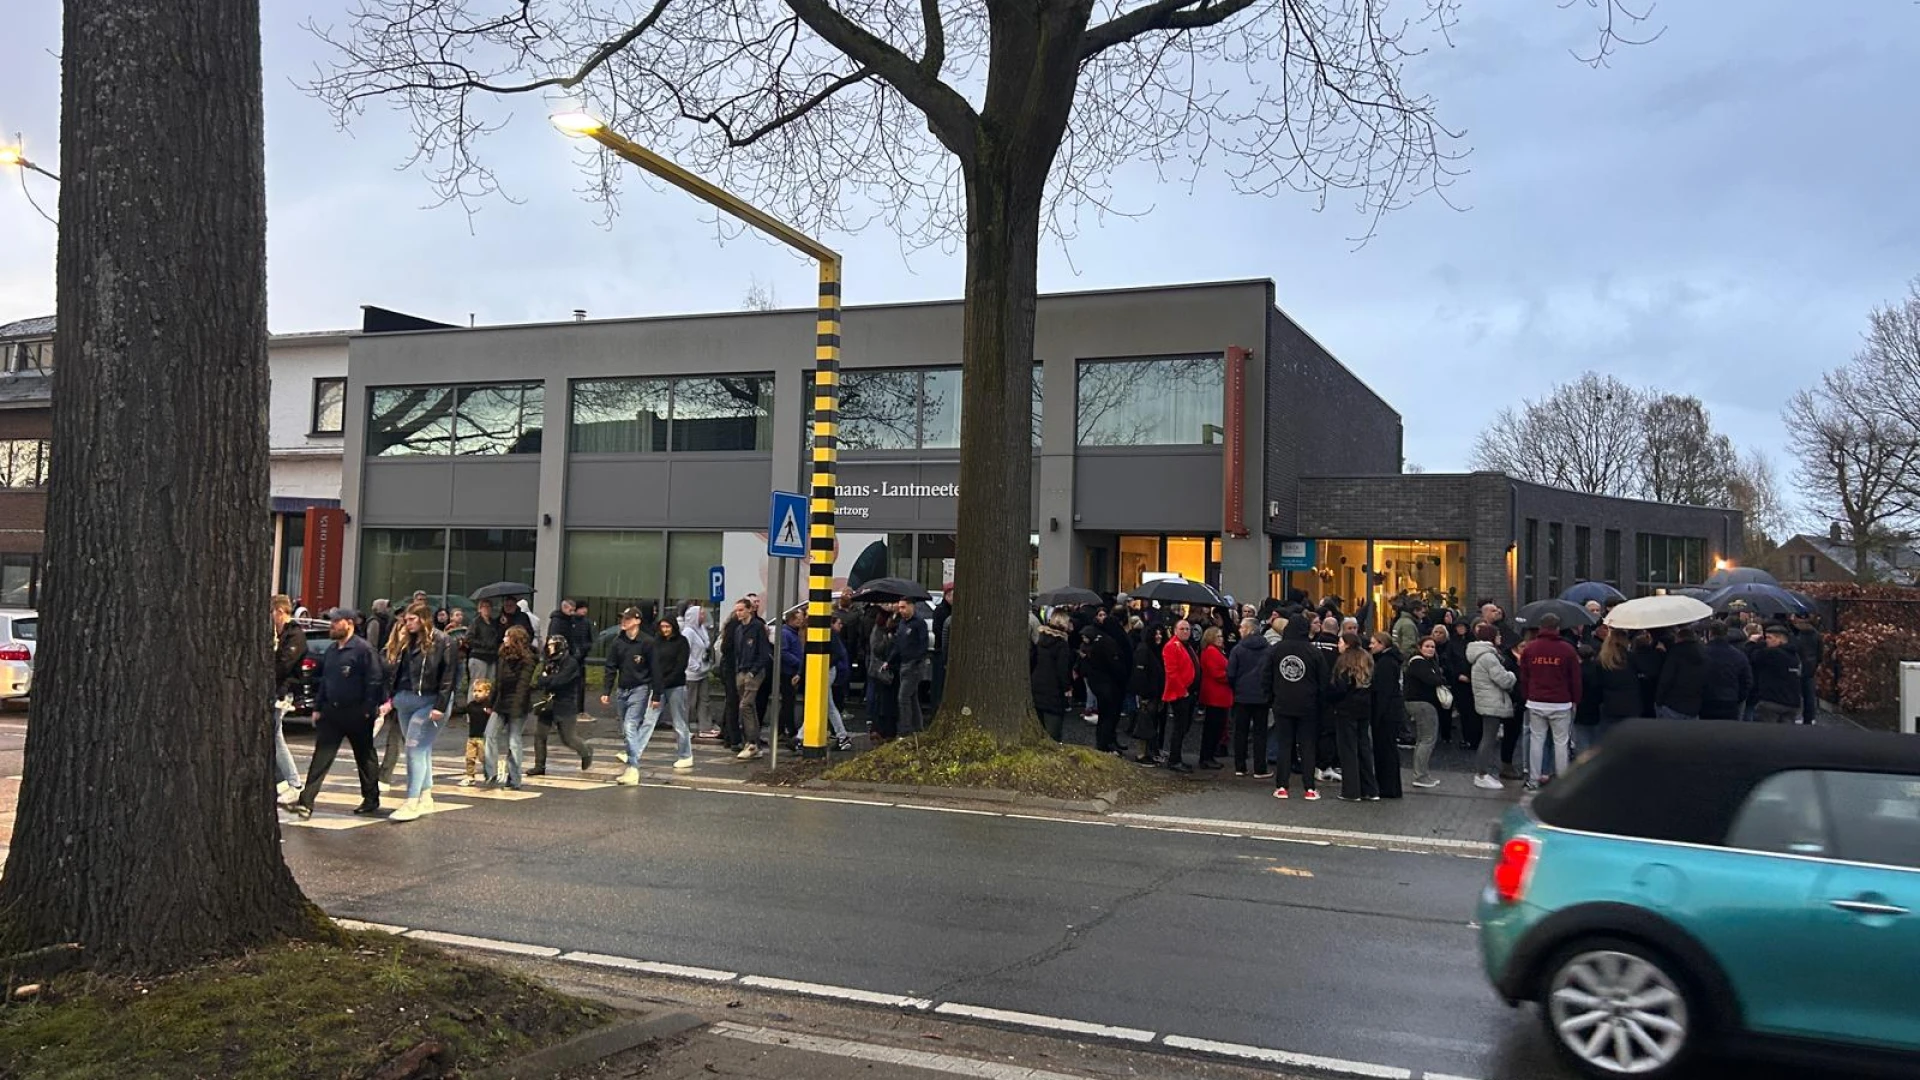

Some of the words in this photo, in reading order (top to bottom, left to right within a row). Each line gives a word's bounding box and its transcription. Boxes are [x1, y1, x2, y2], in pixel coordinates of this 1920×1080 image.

[811, 482, 870, 497] mans
[882, 481, 960, 497] Lantmeete
[712, 571, 723, 597] P
[1532, 656, 1561, 665] JELLE
